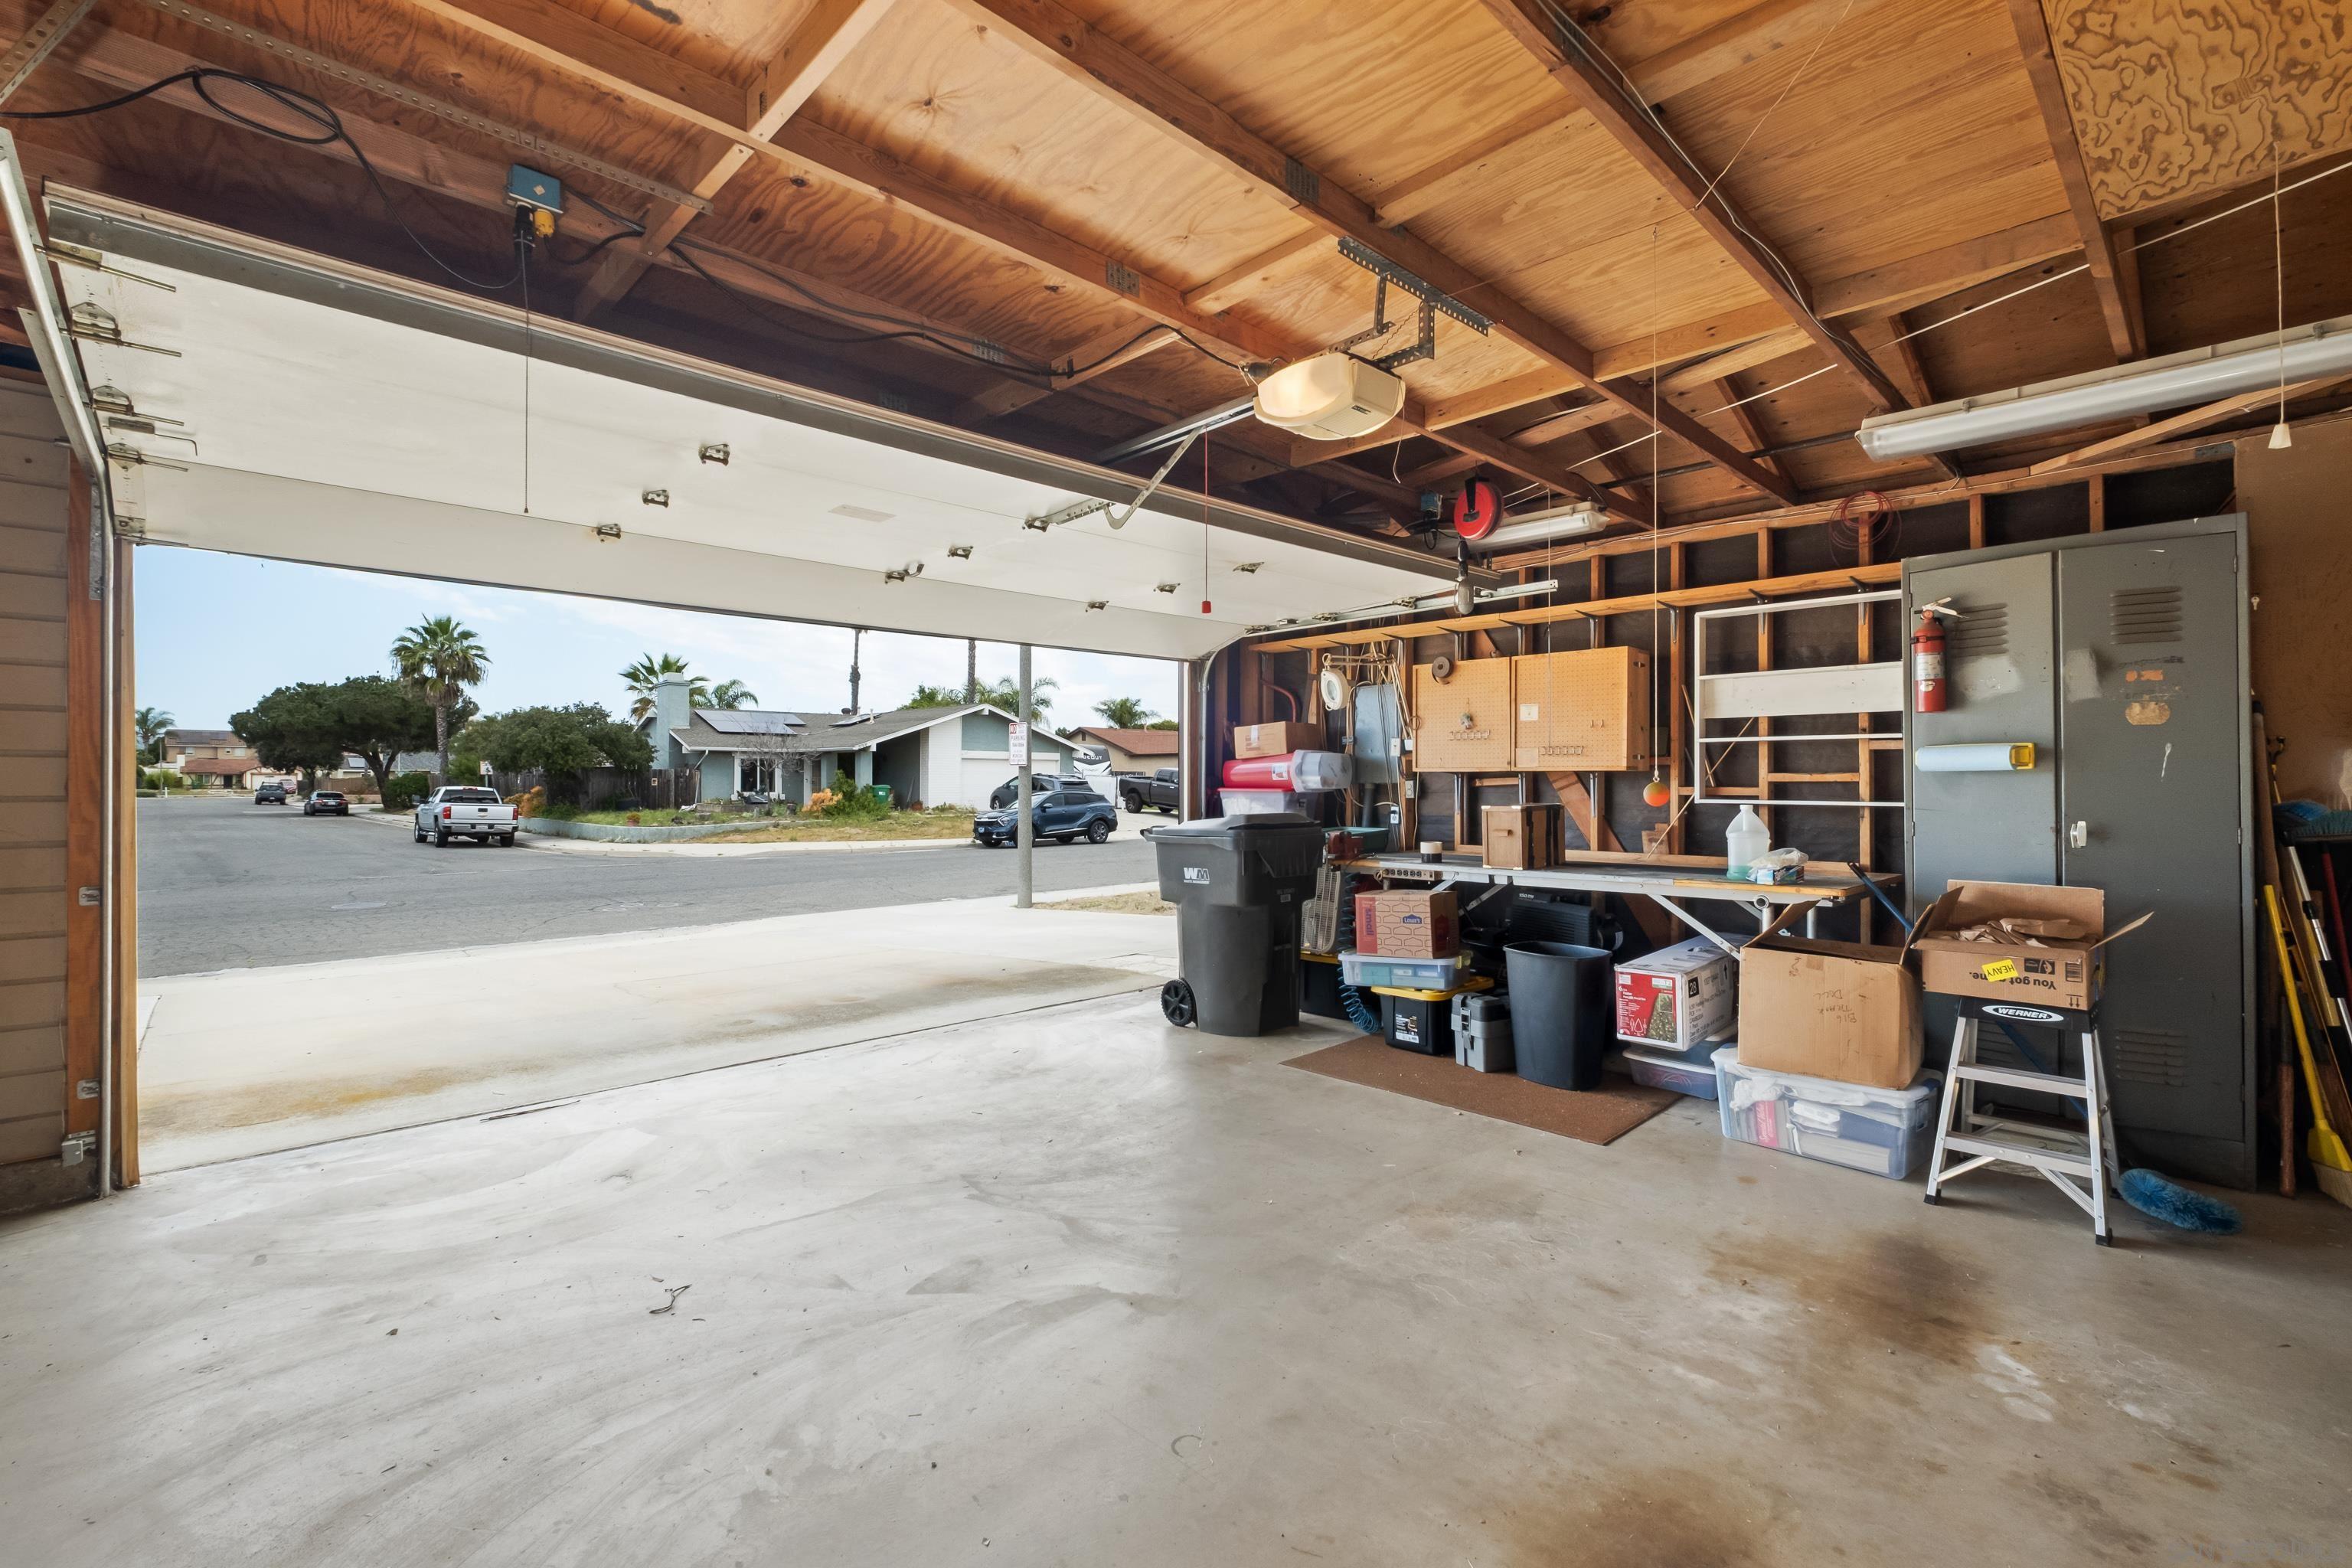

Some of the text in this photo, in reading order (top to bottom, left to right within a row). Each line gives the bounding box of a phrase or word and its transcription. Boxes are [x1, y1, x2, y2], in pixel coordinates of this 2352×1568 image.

[1184, 867, 1210, 880] WM
[1986, 963, 2015, 977] HEAVY
[1689, 981, 1698, 995] 28
[2033, 978, 2057, 991] You
[1997, 1007, 2049, 1020] WERNER
